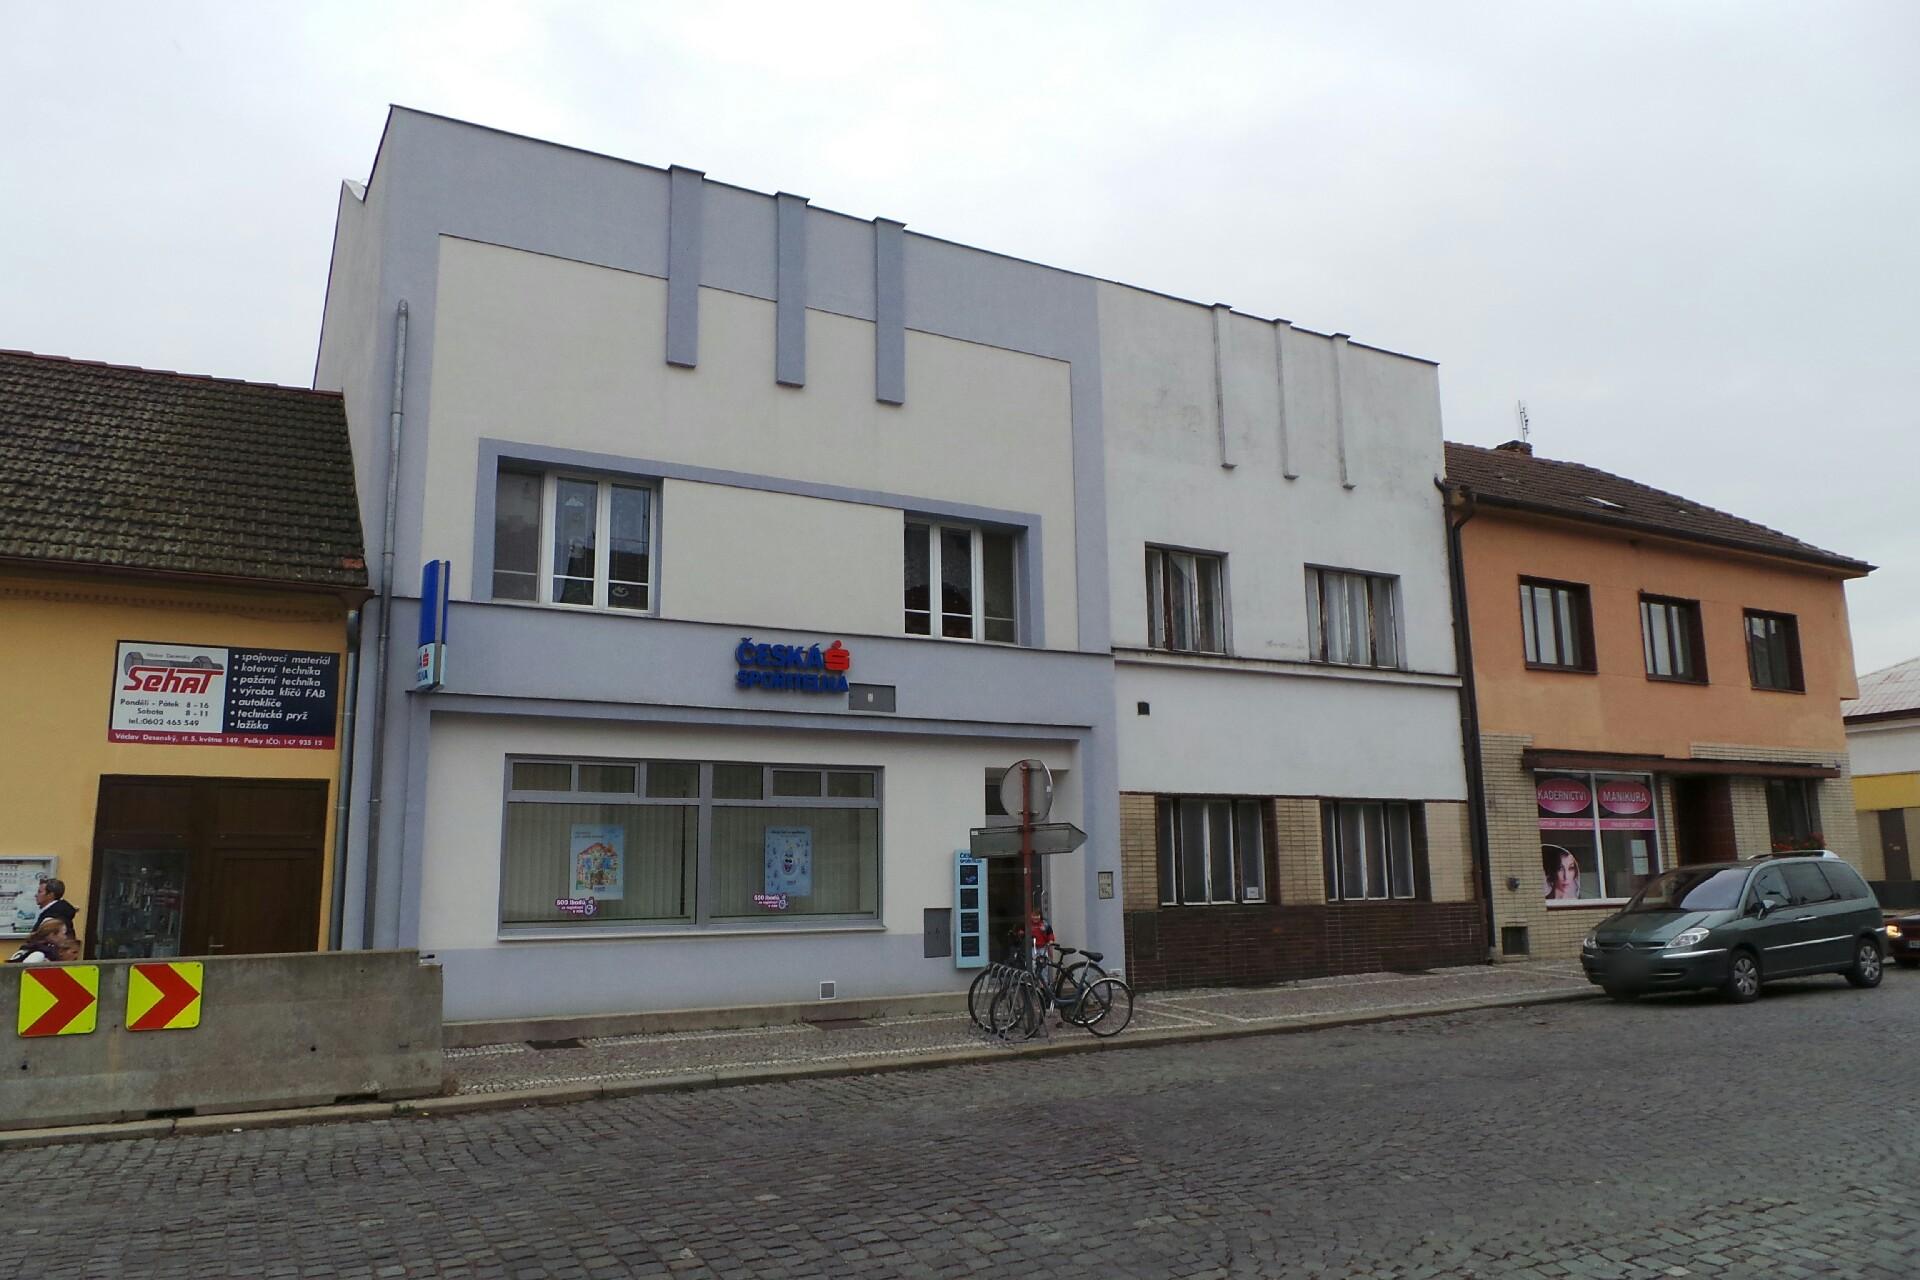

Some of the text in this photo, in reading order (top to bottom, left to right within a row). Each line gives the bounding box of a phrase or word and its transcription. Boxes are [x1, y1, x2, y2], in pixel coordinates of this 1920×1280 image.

[242, 653, 331, 665] spojovací materiál
[736, 636, 823, 670] ČESKÁ
[241, 663, 321, 675] kotevní technika
[282, 677, 321, 686] technika
[240, 686, 274, 696] výroba
[305, 689, 326, 698] FAB
[238, 698, 282, 707] autoklíče
[238, 708, 309, 721] technická pryž
